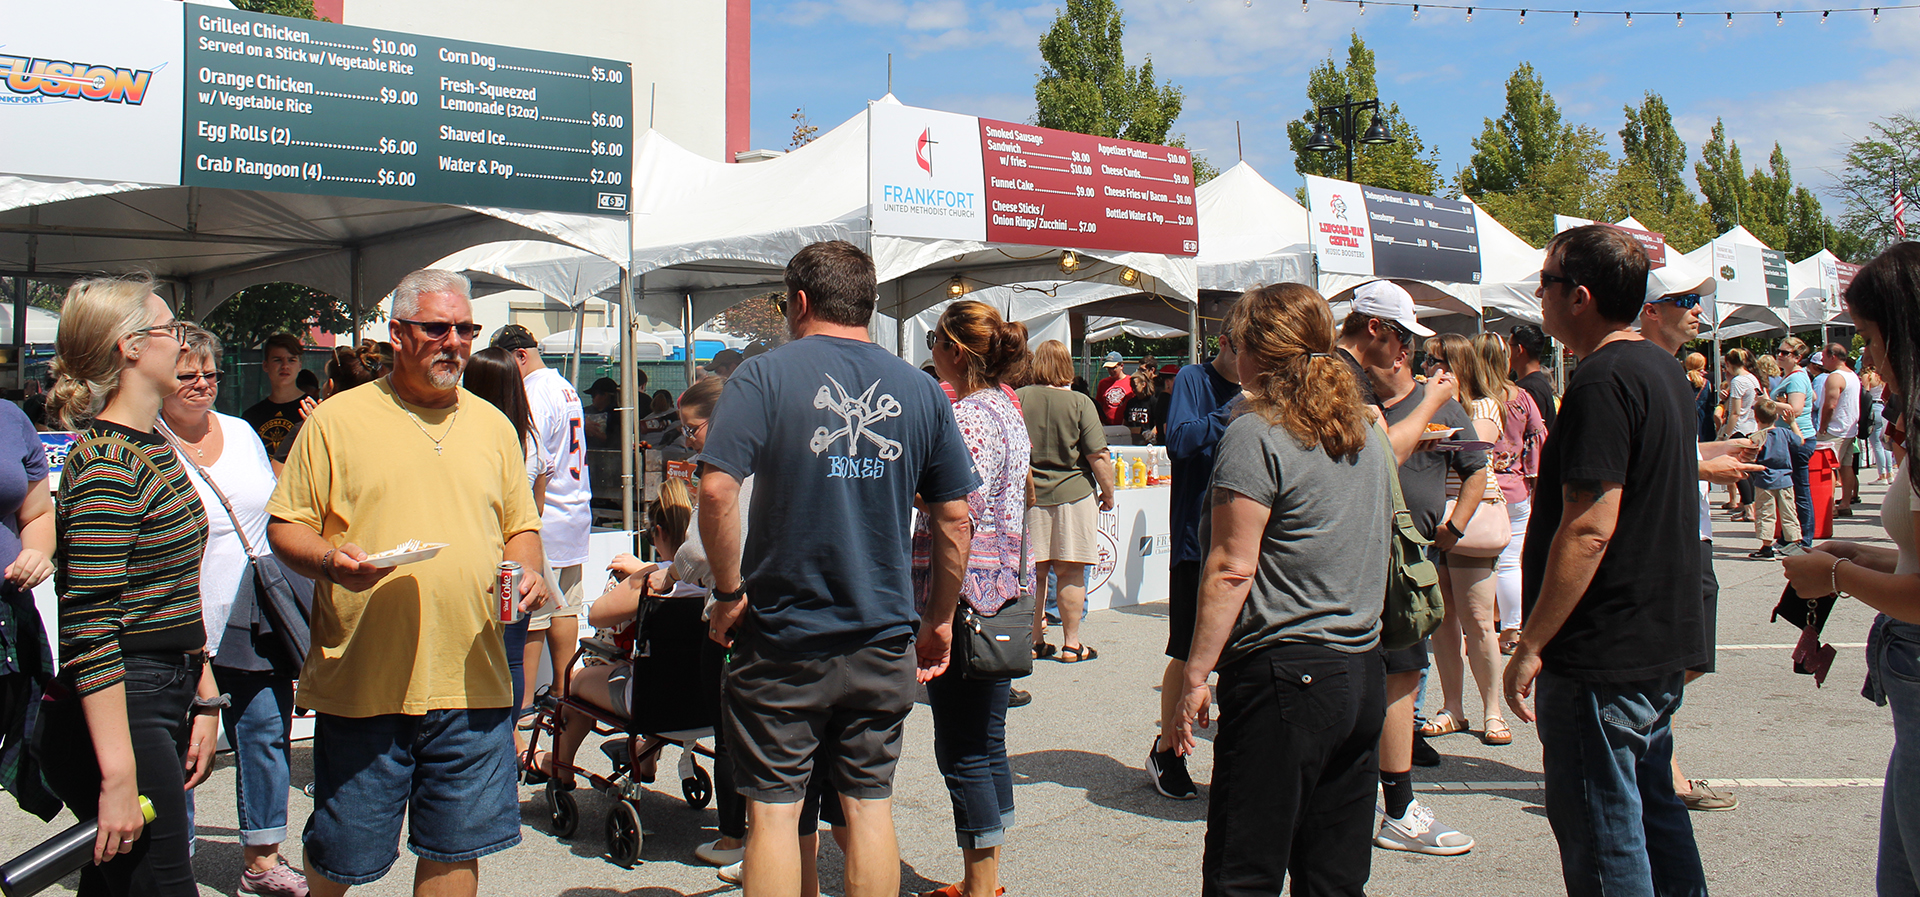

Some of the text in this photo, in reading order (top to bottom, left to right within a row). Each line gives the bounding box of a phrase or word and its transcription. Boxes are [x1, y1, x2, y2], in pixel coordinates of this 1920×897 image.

[199, 15, 417, 57] Grilled Chicken $10.00
[199, 36, 414, 75] Served on a Stick w/ Vegetable Rice
[439, 47, 623, 84] Corn Dog $5.00
[199, 67, 418, 106] Orange Chicken $9.00
[440, 77, 537, 101] Fresh-Squeezed
[199, 90, 313, 114] w/ Vegetable Rice
[440, 95, 624, 128] Lemonade (32oz) $6.00
[198, 120, 418, 156] Egg Rolls (2) $6.00
[440, 125, 623, 157] Shaved Ice $6.00
[985, 126, 1044, 146] Smoked Sausage
[987, 139, 1090, 163] Sandwich $8.00
[1098, 143, 1187, 165] Appetizer Platter $10.00
[197, 154, 416, 187] Crab Rangoon (4) $6.00
[439, 156, 622, 185] Water & Pop $2.00
[999, 154, 1092, 176] w/ fries $10.00
[1101, 164, 1189, 185] Cheese Curds $9.00
[884, 185, 974, 209] FRANKFORT
[991, 176, 1095, 197] Funnel Cake $9.00
[1104, 185, 1125, 197] Cheese
[1126, 188, 1140, 199] Fries
[1141, 190, 1149, 201] w/
[1150, 191, 1168, 202] Bacon
[884, 204, 975, 218] UNITED METHODIST CHURCH
[992, 200, 1017, 212] Cheese
[1019, 202, 1040, 215] Sticks
[1106, 208, 1193, 226] Bottled Water & Pop $2.00
[993, 214, 1014, 226] Onion
[1039, 218, 1067, 230] Zucchini
[1079, 221, 1096, 233] $7.00
[1319, 222, 1364, 237] LINCOLN-WAY
[1325, 248, 1364, 258] MUSIC BOOSTERS
[1329, 235, 1359, 248] CENTRAL
[827, 455, 884, 479] BONES
[501, 575, 511, 600] Coke
